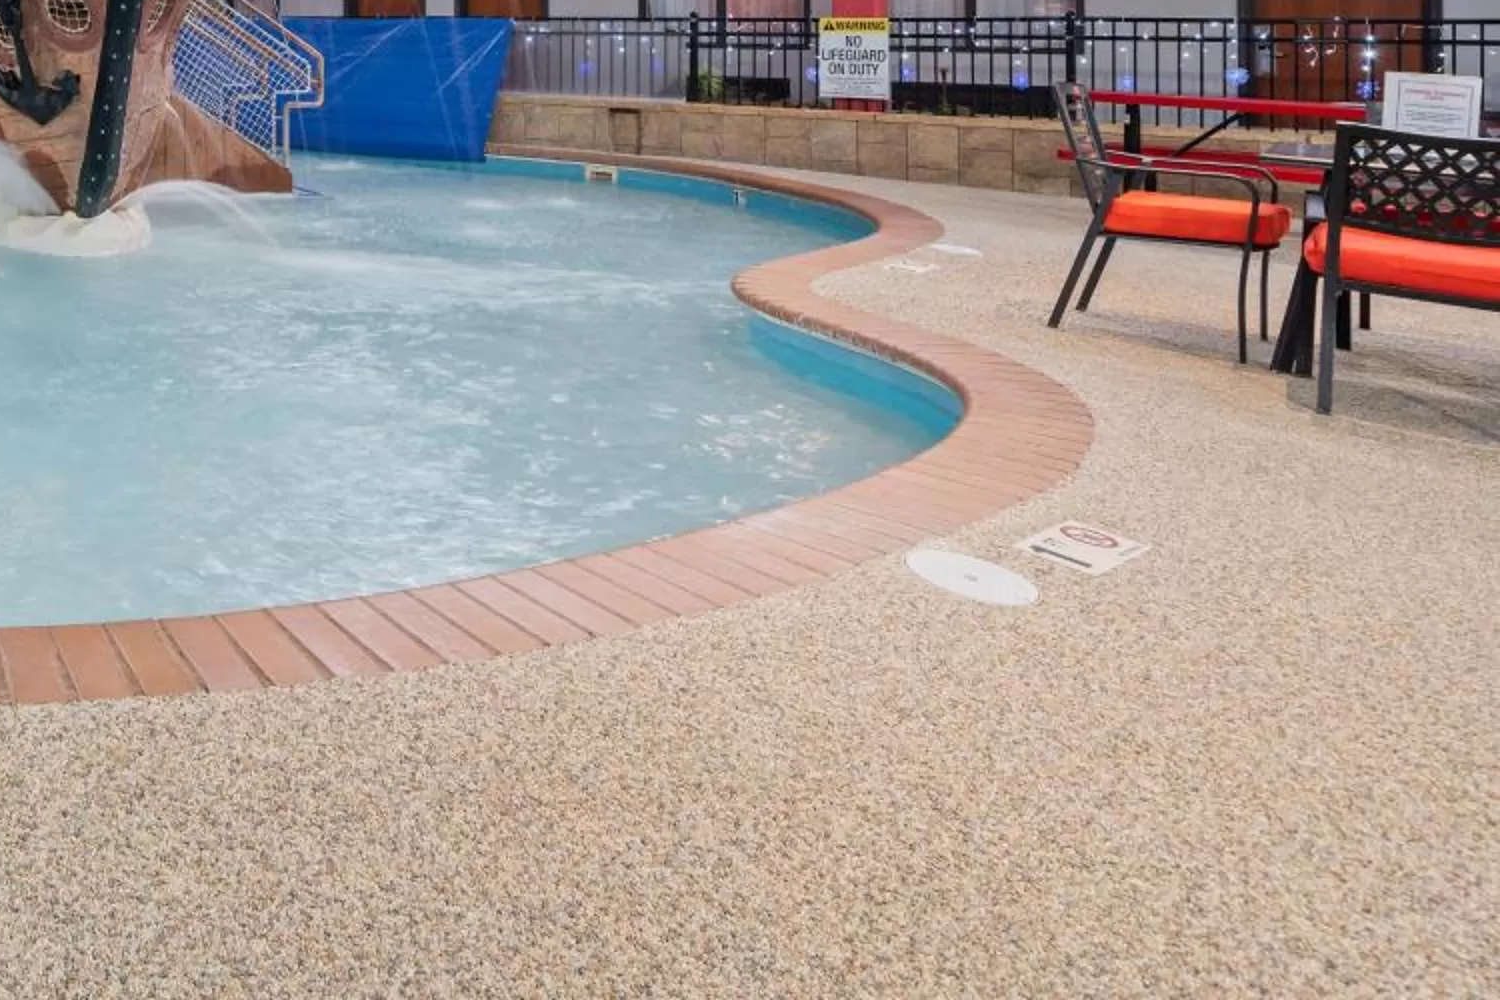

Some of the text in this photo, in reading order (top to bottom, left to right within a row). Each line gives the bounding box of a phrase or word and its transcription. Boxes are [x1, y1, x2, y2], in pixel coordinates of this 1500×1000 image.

[835, 21, 886, 31] WARNING
[845, 35, 863, 48] NO
[821, 49, 886, 63] LIFEGUARD
[828, 62, 880, 76] ON DUTY
